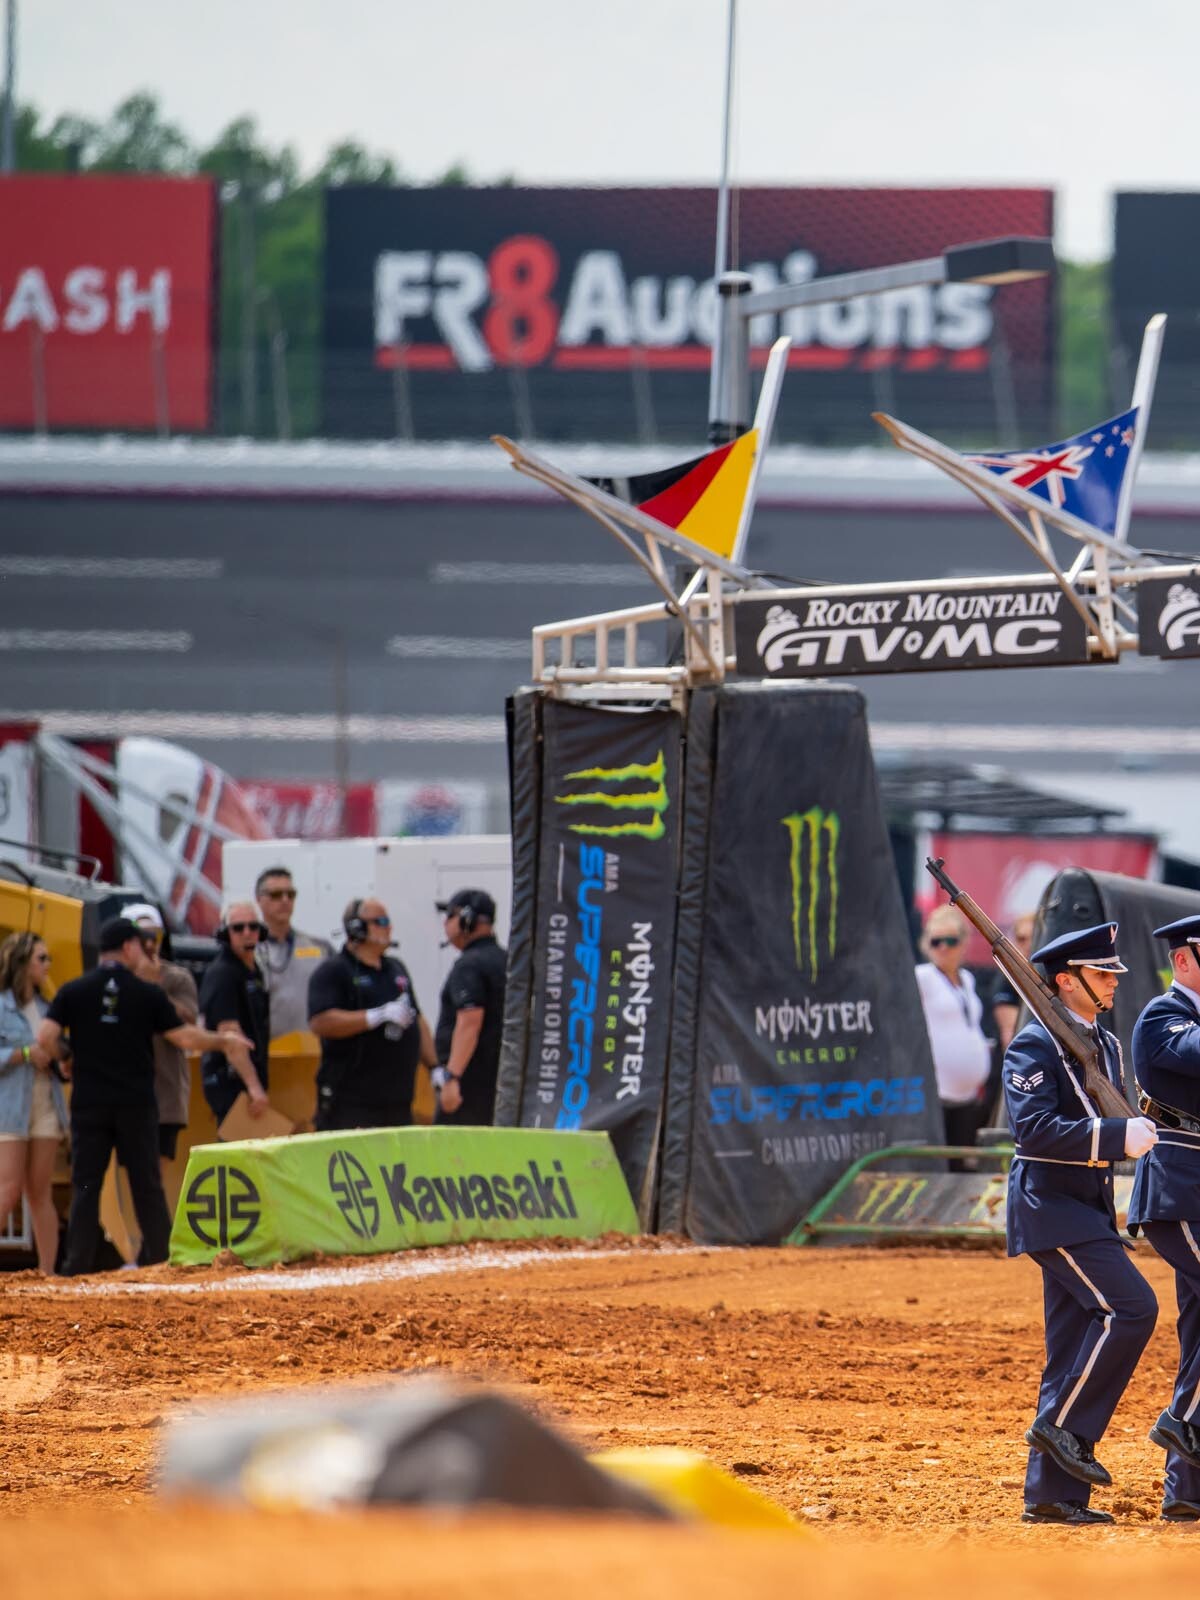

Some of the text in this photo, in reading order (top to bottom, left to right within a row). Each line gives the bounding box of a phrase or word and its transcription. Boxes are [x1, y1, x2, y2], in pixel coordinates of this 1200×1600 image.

[0, 265, 171, 335] ASH
[802, 590, 1063, 628] ROCKY MOUNTAIN
[605, 851, 620, 894] AMA
[536, 913, 569, 1104] CHAMPIONSHIP
[554, 841, 606, 1131] SUPERCROS
[603, 949, 623, 1073] ENERGY
[616, 921, 656, 1101] MONSTER
[755, 996, 874, 1043] MONSTER
[776, 1046, 858, 1065] ENERGY
[708, 1076, 925, 1126] SUPERCROSS
[380, 1159, 580, 1226] Kawasaki
